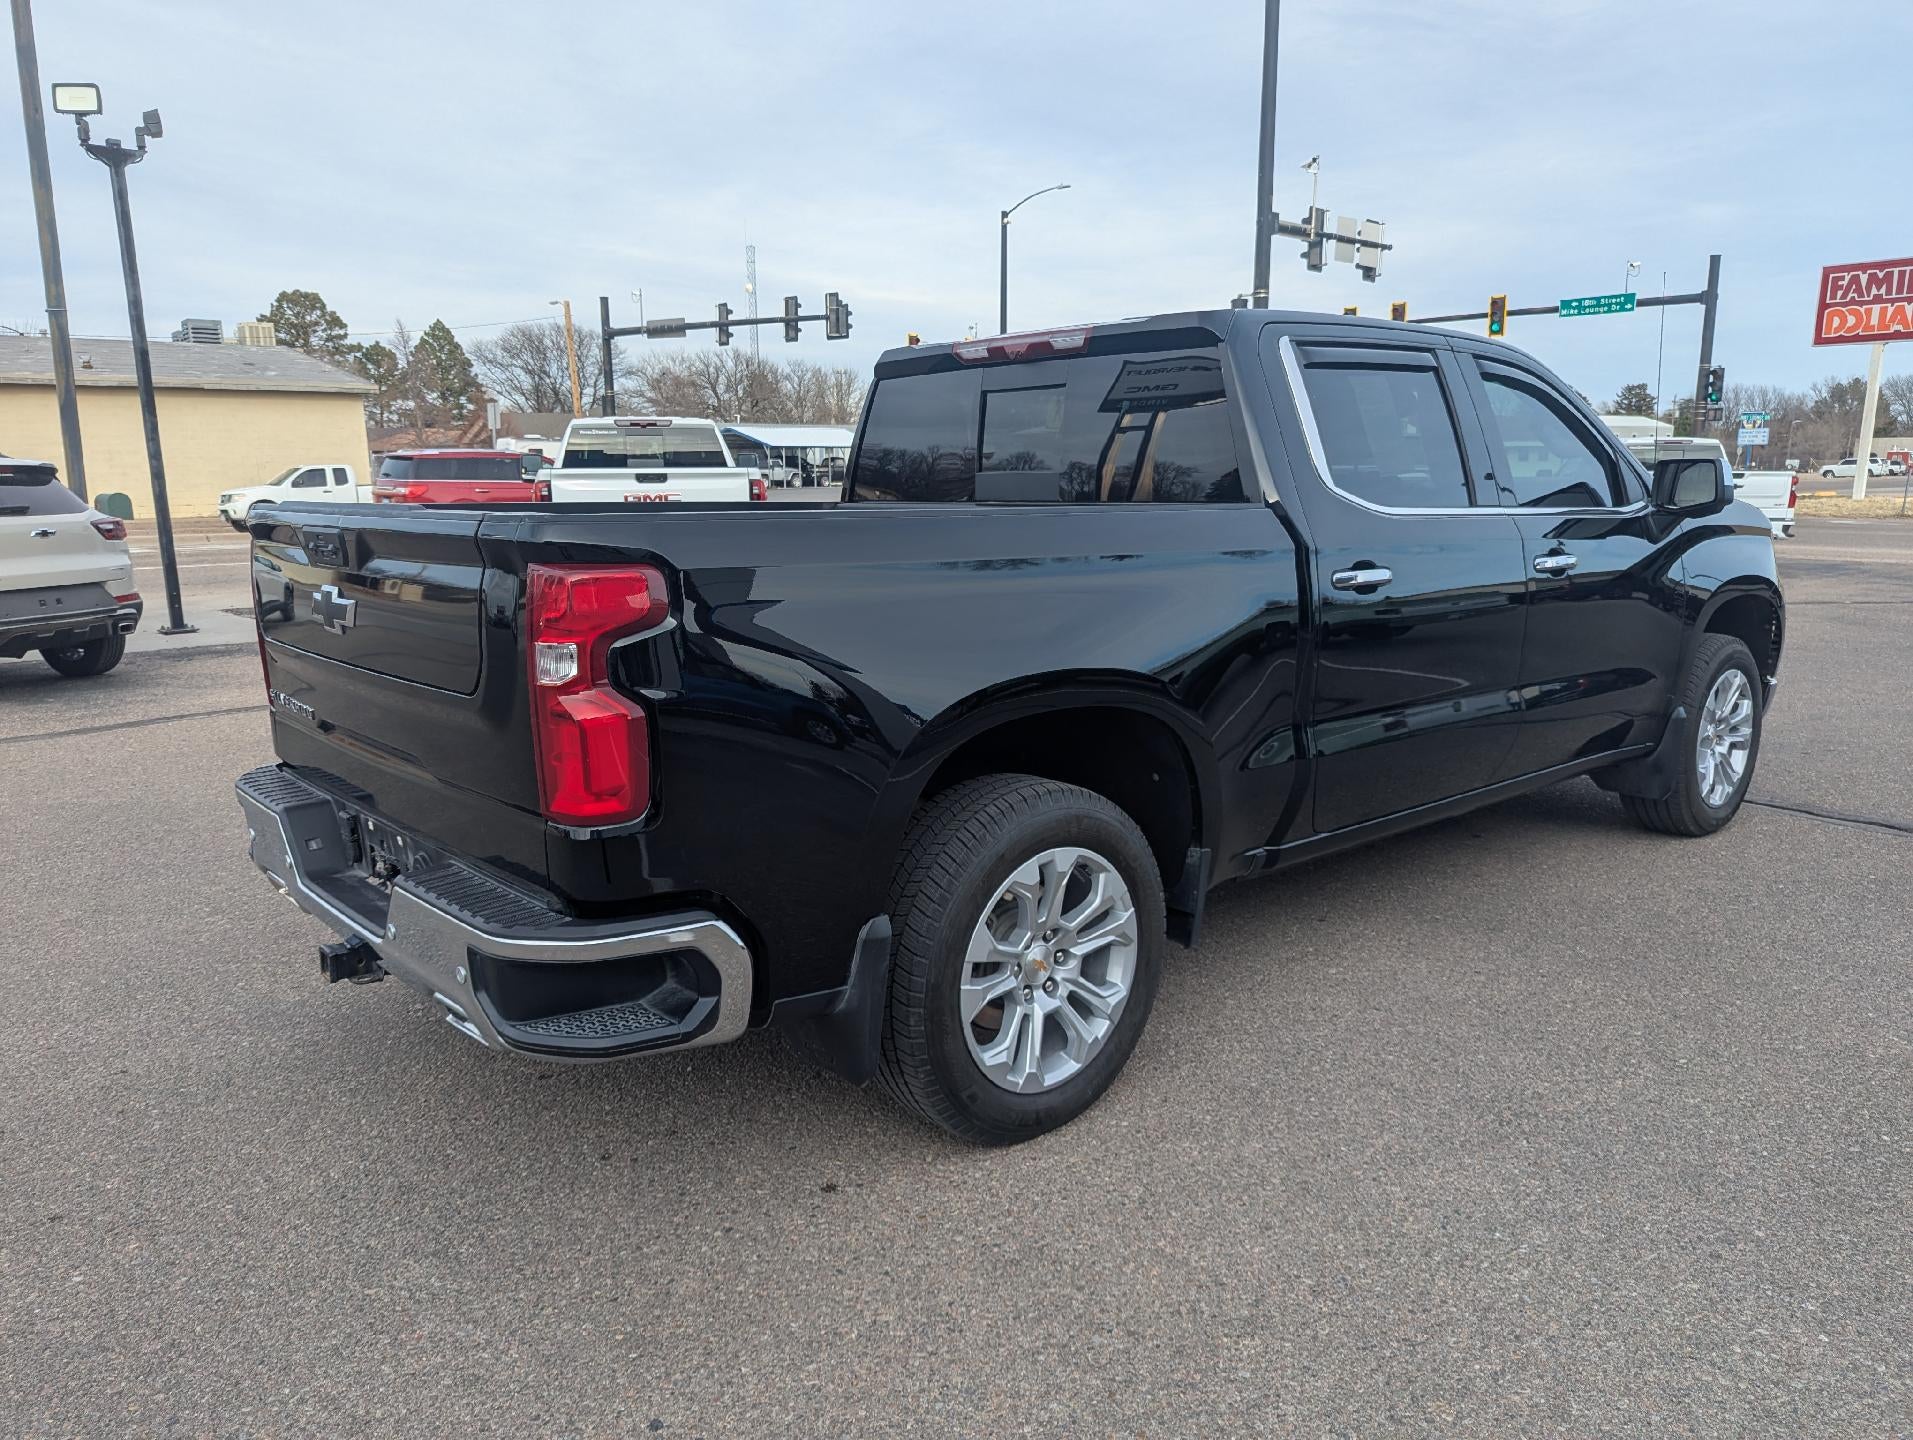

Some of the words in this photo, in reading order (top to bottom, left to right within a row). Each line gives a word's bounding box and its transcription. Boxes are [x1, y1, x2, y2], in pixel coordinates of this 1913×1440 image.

[1600, 296, 1624, 305] Street
[1561, 307, 1579, 316] Mike
[1581, 304, 1608, 314] Lounge
[1822, 302, 1913, 337] DOLLA
[624, 492, 682, 502] GMC
